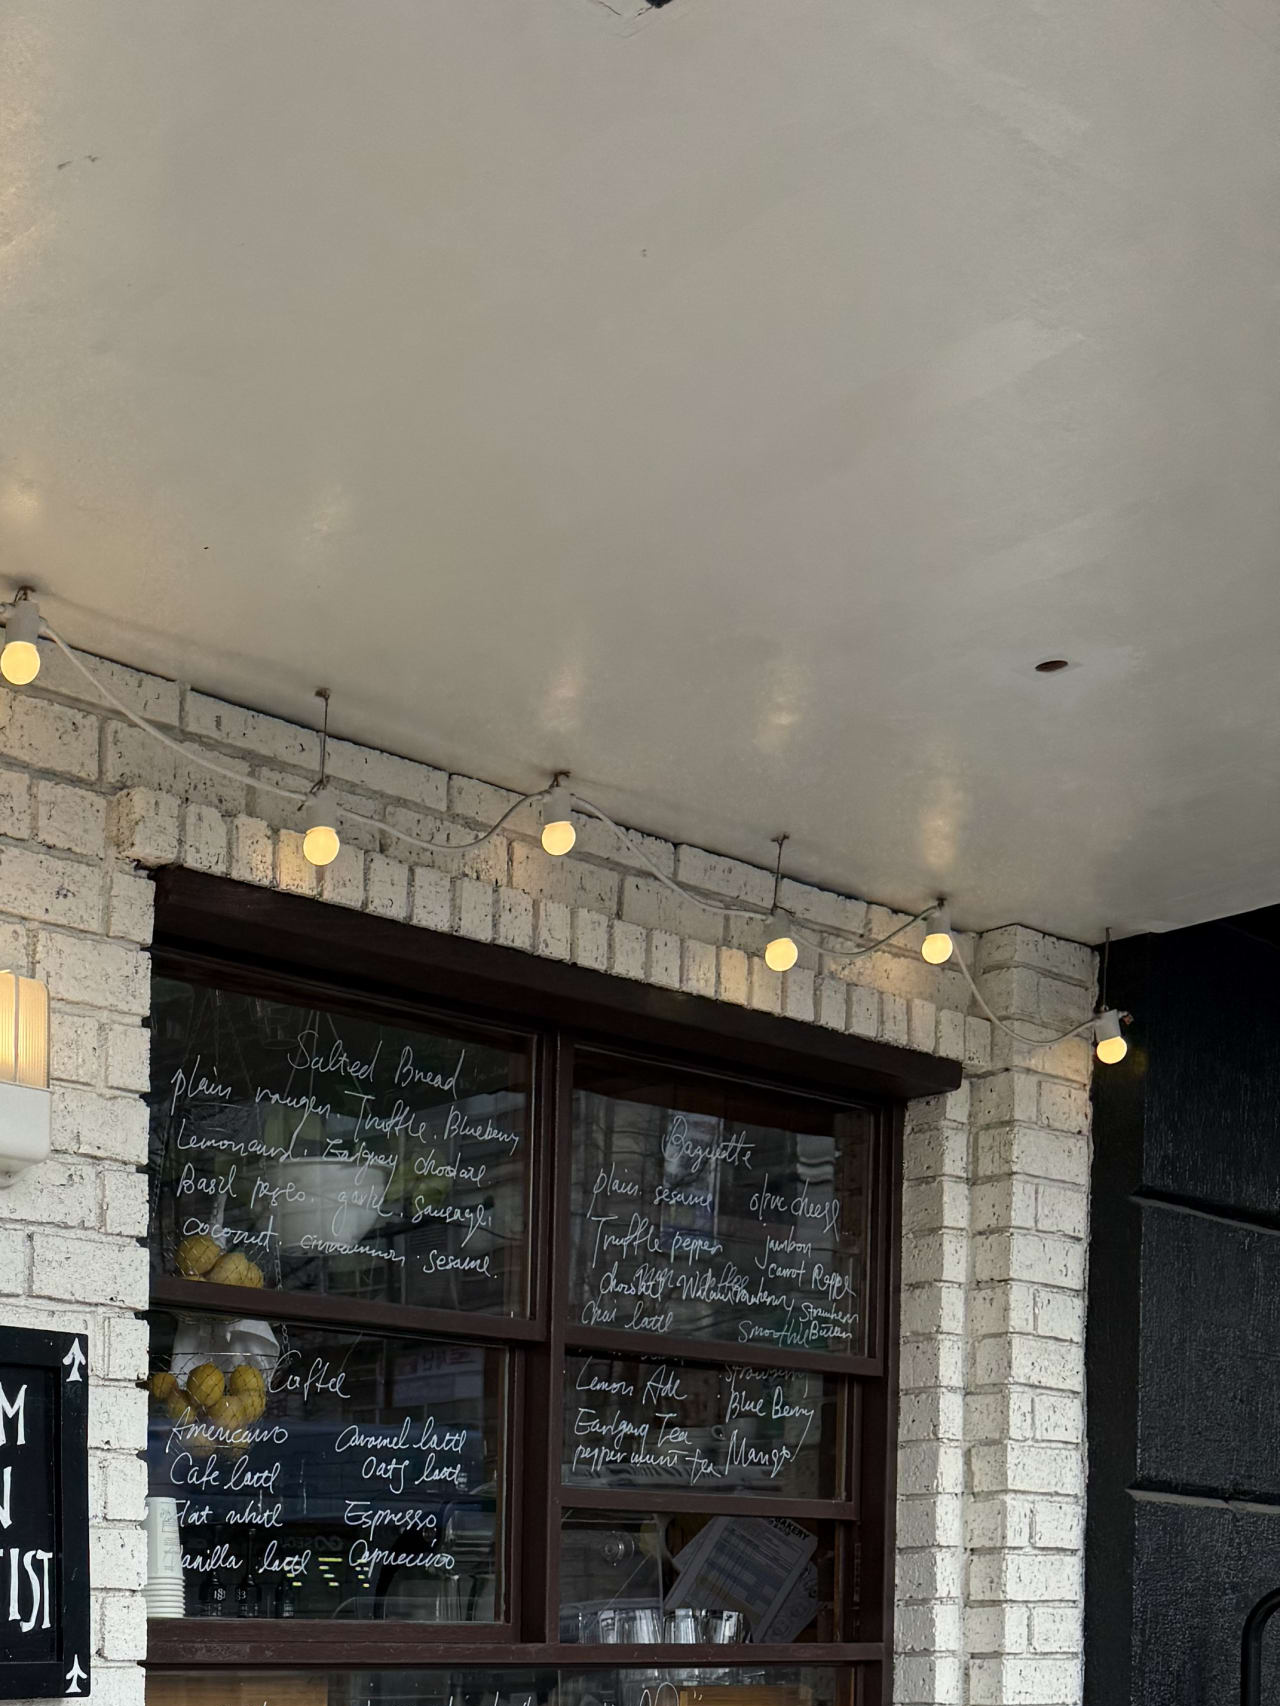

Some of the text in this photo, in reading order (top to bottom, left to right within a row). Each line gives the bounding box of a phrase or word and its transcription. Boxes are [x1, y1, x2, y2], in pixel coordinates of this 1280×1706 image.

[287, 1030, 465, 1100] Salted Bread
[661, 1115, 756, 1173] Baguette
[655, 1413, 693, 1448] Tea
